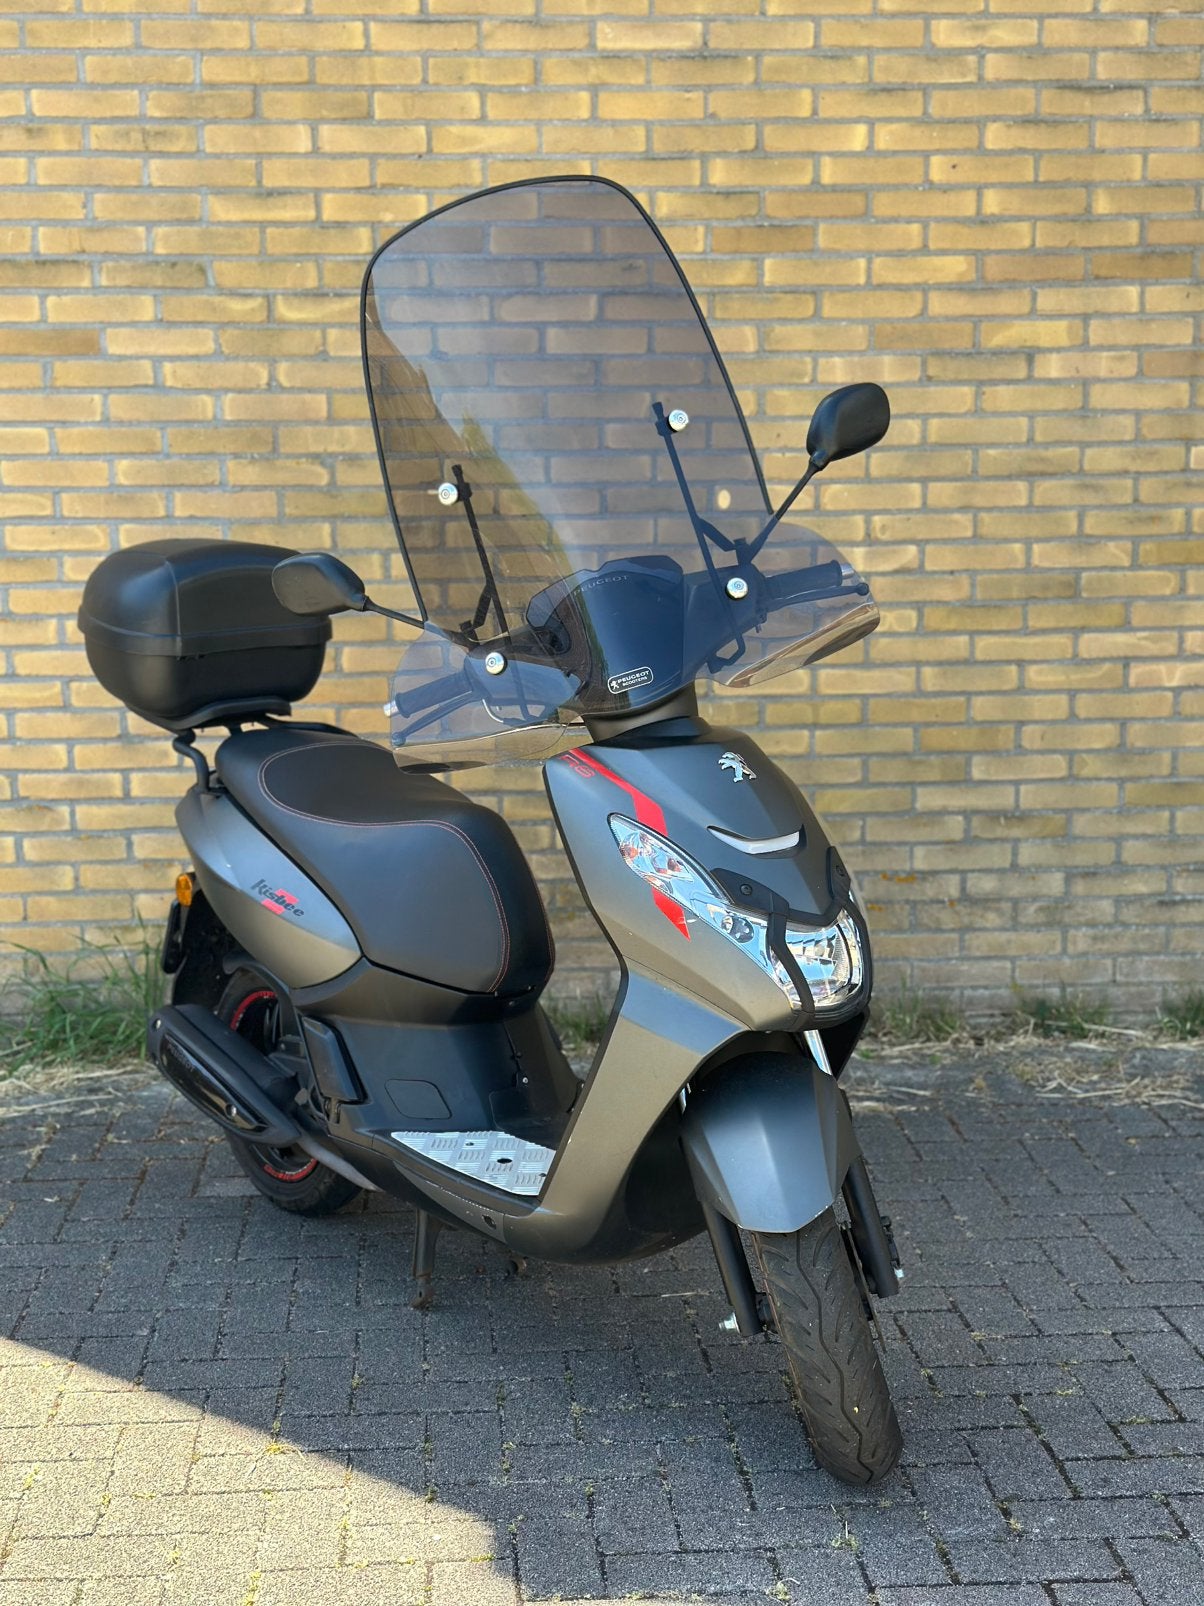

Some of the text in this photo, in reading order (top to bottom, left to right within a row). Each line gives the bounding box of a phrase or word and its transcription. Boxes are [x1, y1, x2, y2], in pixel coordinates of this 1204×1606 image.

[617, 670, 650, 684] PEUGEOT
[622, 676, 648, 687] SCOOTERS
[250, 878, 304, 917] Kisbee
